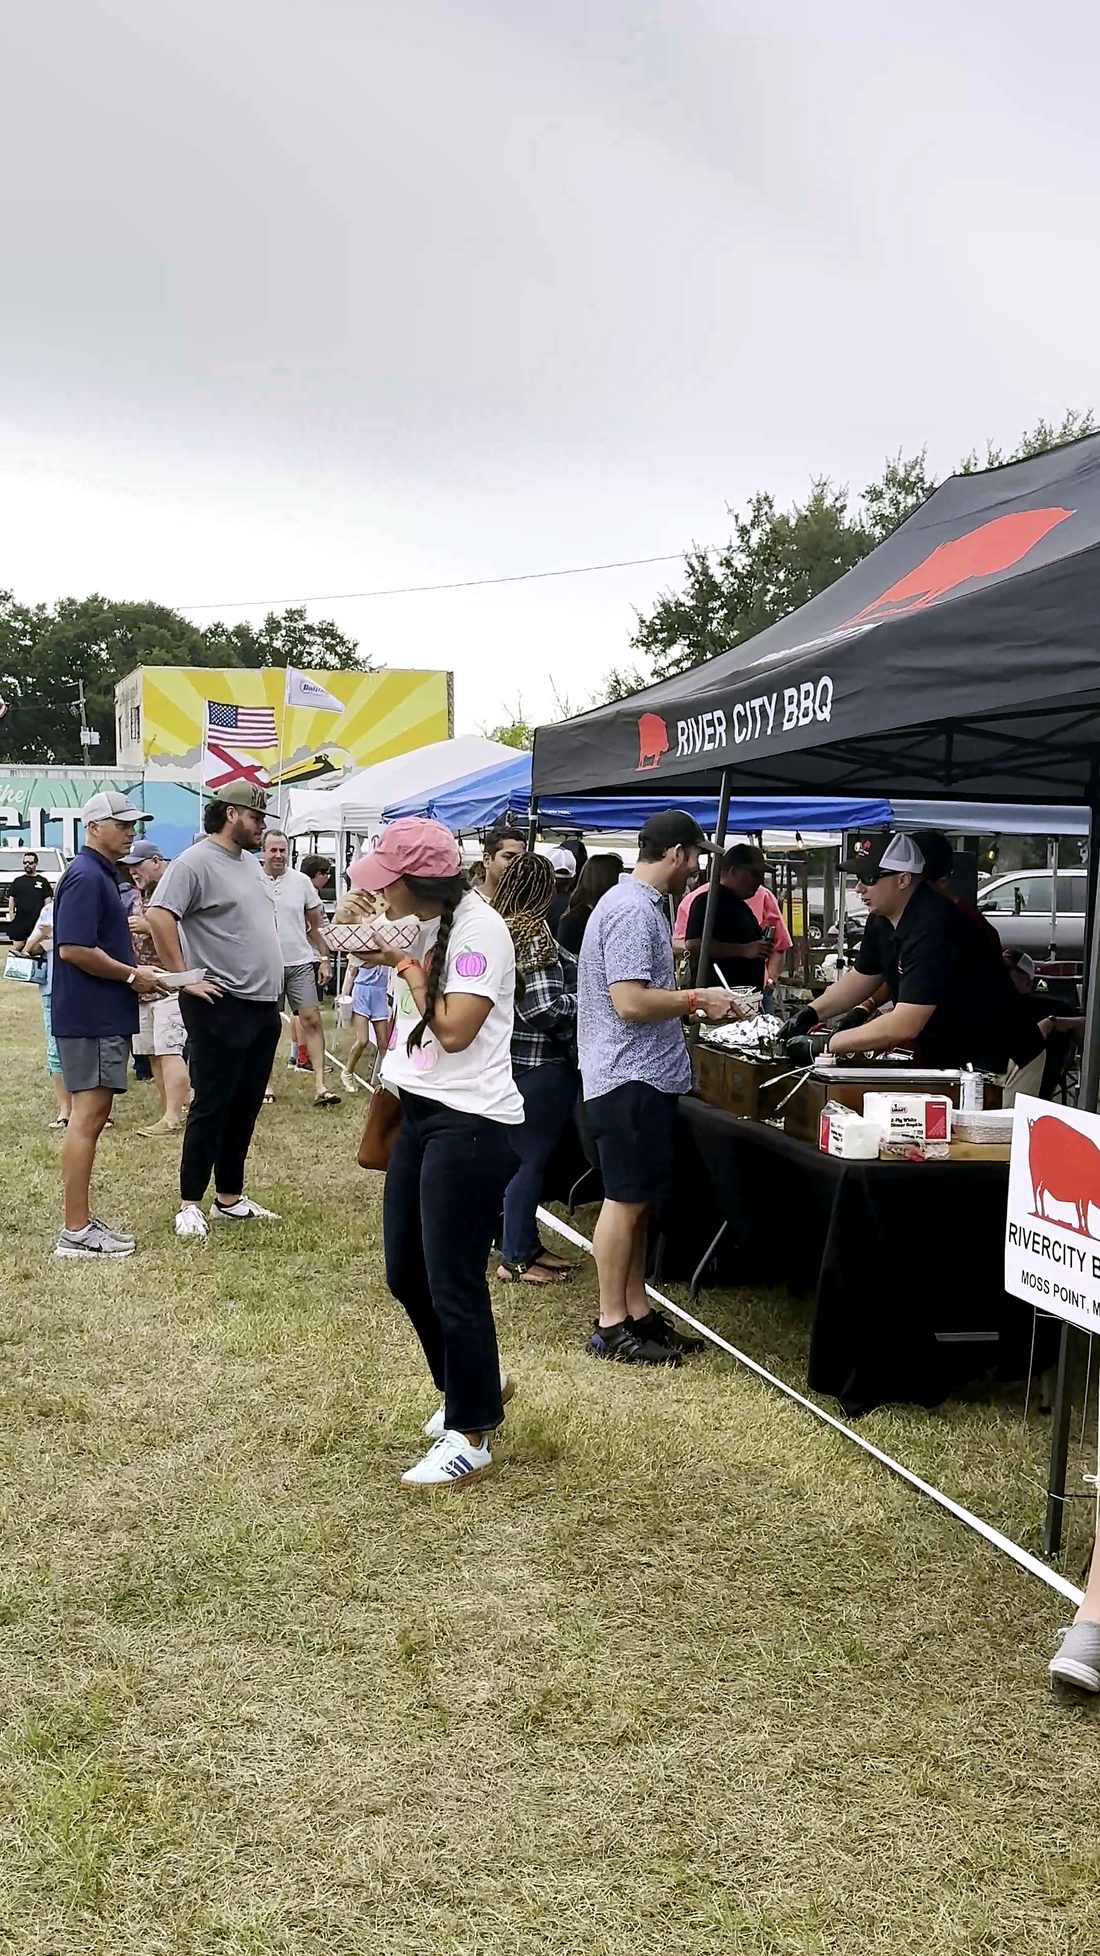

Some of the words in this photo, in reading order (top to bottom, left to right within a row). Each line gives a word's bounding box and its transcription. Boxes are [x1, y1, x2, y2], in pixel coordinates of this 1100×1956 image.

[676, 709, 727, 757] RIVER
[732, 692, 778, 745] CITY
[782, 675, 834, 732] BBQ
[1008, 1222, 1087, 1273] RIVERCITY
[1021, 1269, 1050, 1295] MOSS
